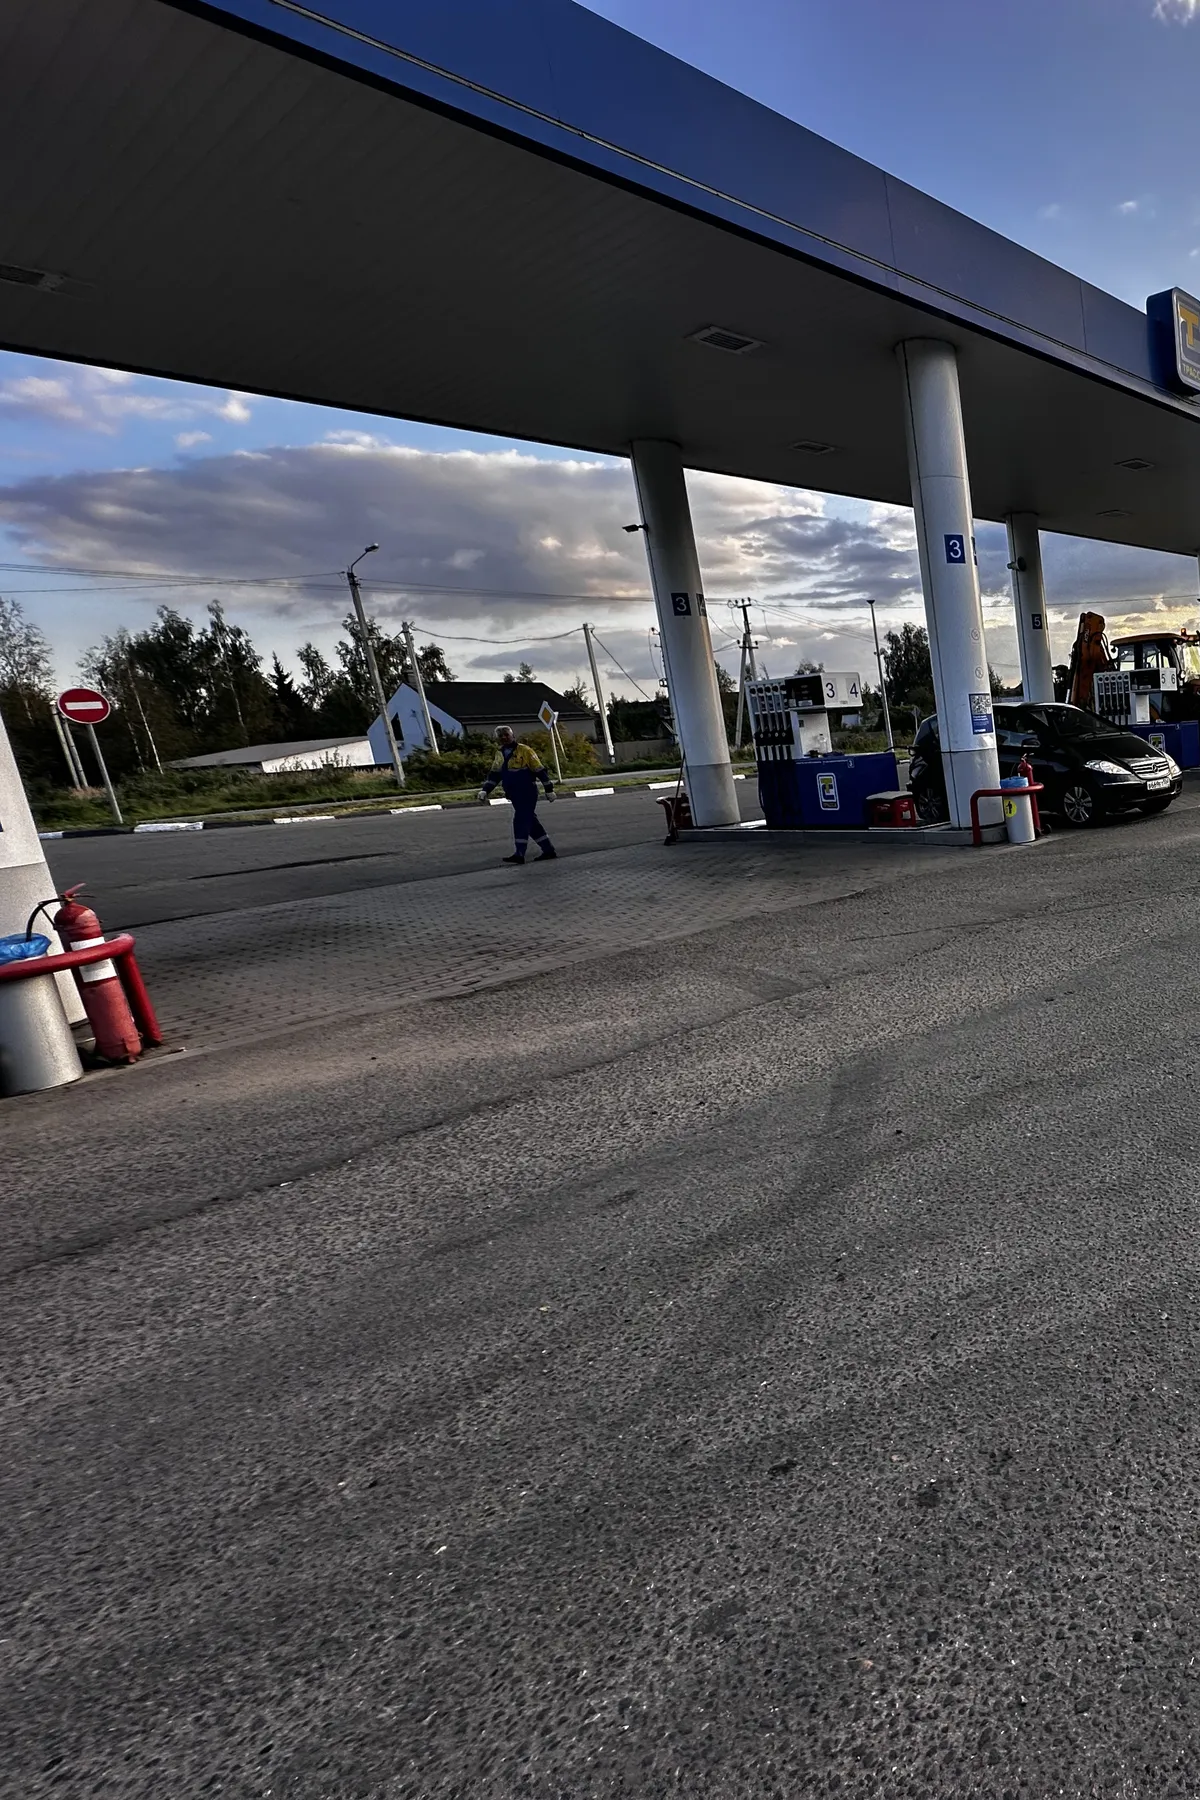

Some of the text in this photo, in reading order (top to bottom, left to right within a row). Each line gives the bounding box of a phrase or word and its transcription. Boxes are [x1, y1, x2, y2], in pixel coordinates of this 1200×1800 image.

[949, 539, 962, 559] 3
[675, 596, 687, 612] 3
[1034, 616, 1041, 627] 5
[1161, 673, 1176, 685] 5 6
[825, 682, 859, 699] 3 4
